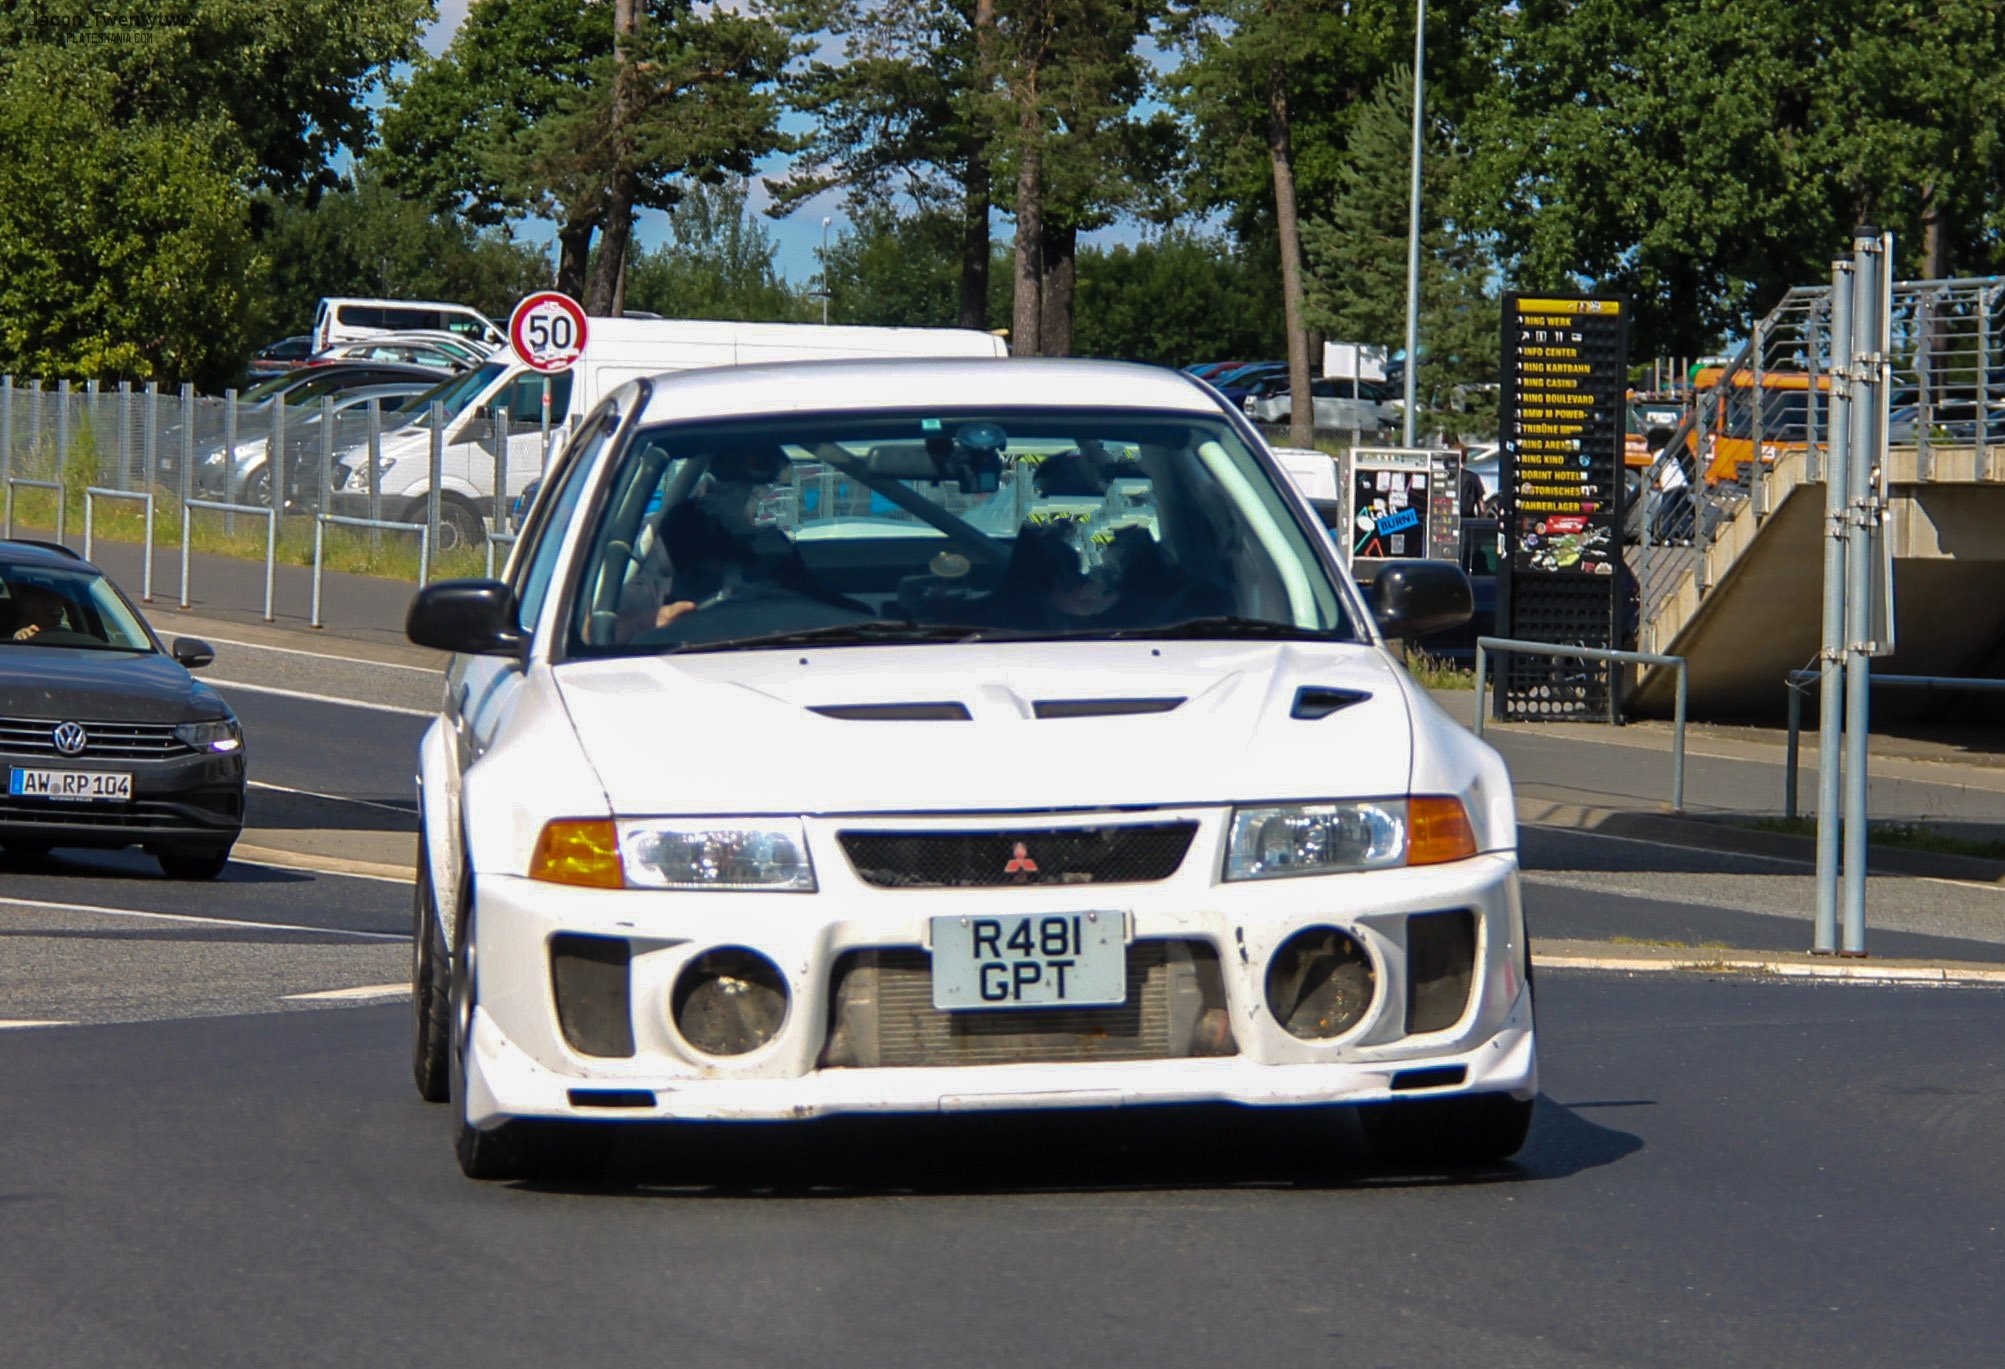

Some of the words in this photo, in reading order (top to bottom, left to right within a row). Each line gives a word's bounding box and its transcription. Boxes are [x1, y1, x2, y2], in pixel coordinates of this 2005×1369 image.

[1524, 316, 1545, 327] RING
[1547, 317, 1572, 327] WERK
[529, 315, 571, 352] 50
[1524, 347, 1543, 356] INFO
[1545, 347, 1577, 358] CENTER
[1523, 363, 1544, 373] RING
[1546, 363, 1591, 374] KARTBAHN
[1523, 378, 1544, 388] RING
[1523, 393, 1543, 403] RING
[1545, 394, 1594, 405] BOULEVARD
[1523, 409, 1543, 418] BMW
[1545, 409, 1553, 418] M
[1522, 440, 1542, 450] RING
[1521, 454, 1542, 464] RING
[1544, 455, 1564, 465] KINO
[1521, 469, 1552, 480] DORINT
[1521, 501, 1580, 512] FAHRERLAGER
[25, 773, 50, 792] AW
[63, 774, 89, 794] RP
[92, 776, 129, 796] 104
[972, 916, 1082, 958] R481
[979, 960, 1075, 1001] GPT
